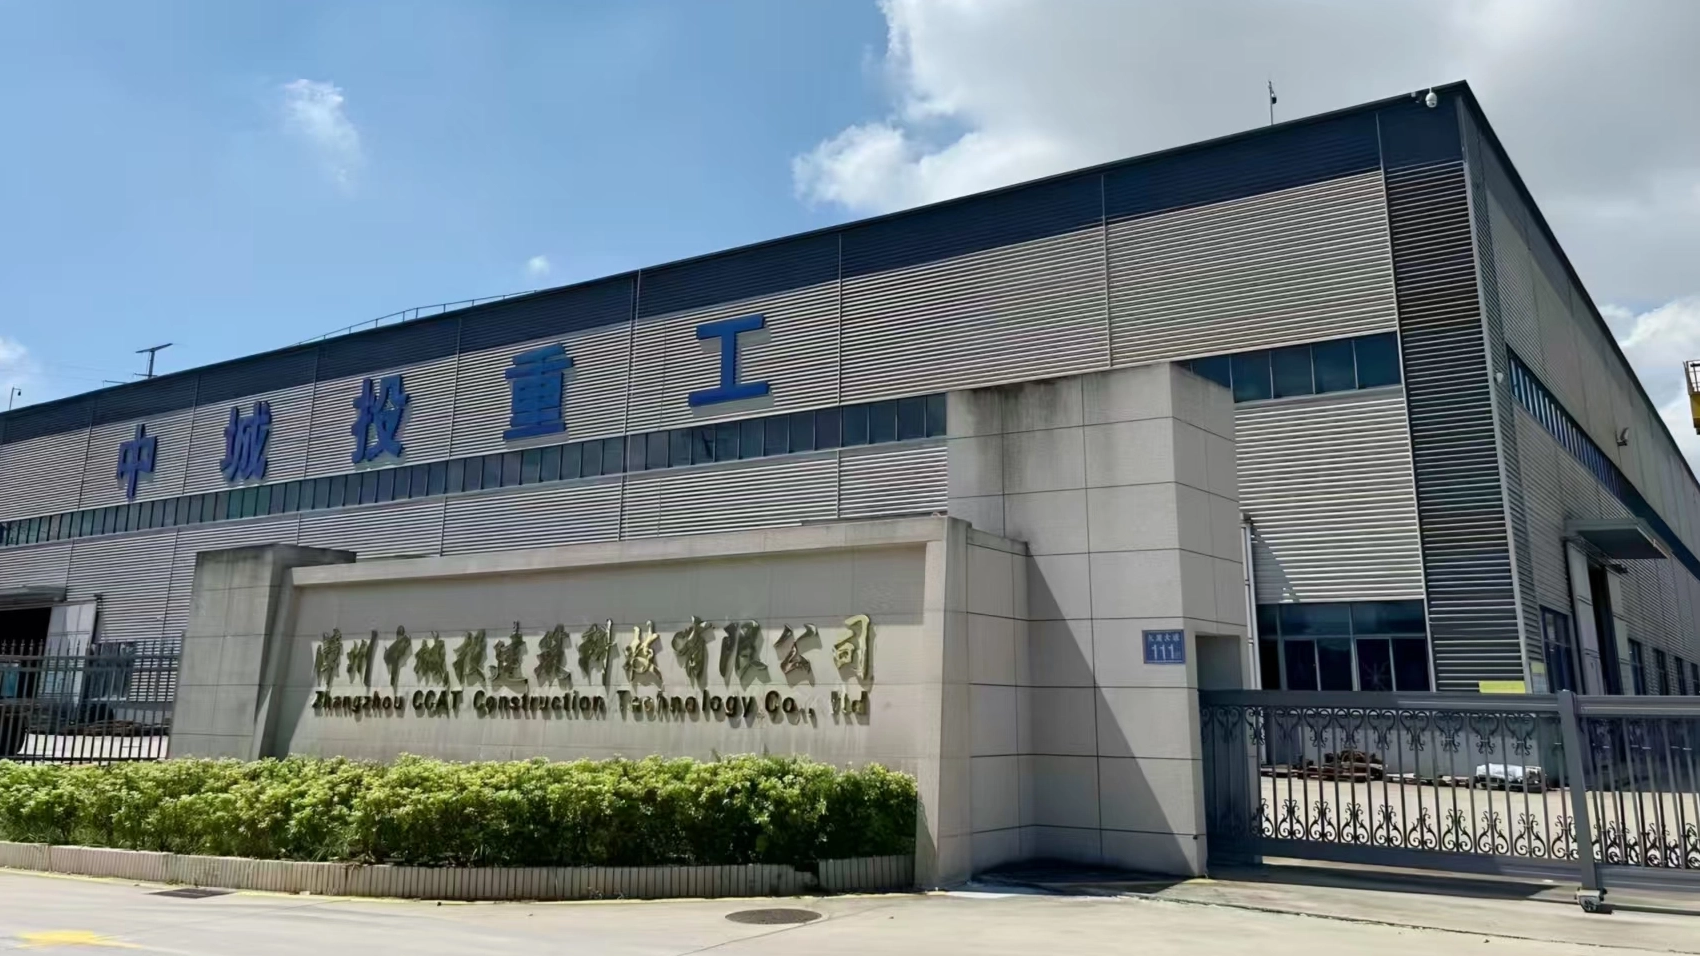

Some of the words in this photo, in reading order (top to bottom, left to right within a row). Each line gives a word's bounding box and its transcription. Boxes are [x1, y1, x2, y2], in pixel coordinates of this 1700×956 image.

[116, 313, 772, 503] 中城投重工
[1151, 643, 1175, 660] 111
[311, 690, 405, 713] Zhangzhou
[412, 689, 463, 711] CCAT
[473, 689, 605, 713] Construction
[617, 689, 757, 718] Technology
